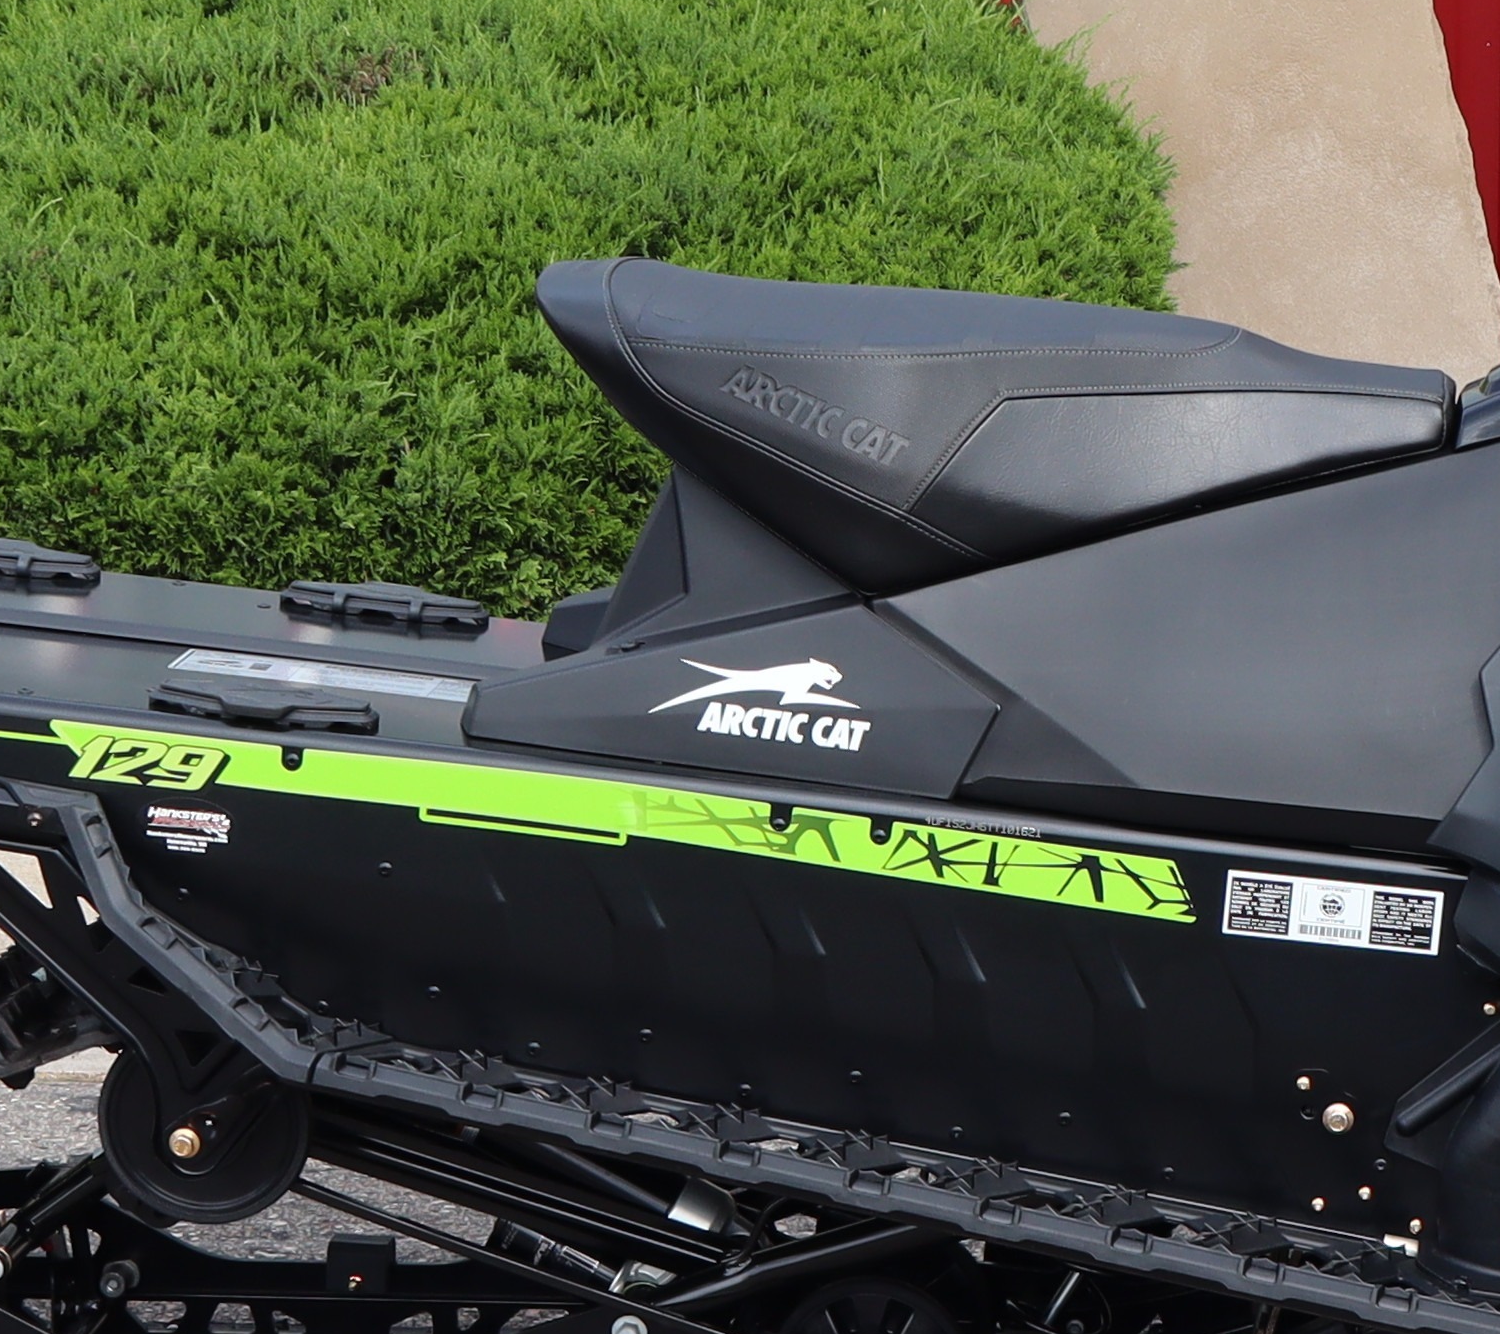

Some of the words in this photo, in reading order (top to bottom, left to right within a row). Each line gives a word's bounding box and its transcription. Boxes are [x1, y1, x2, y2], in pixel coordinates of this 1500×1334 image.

[719, 364, 846, 438] ARCTIC
[841, 417, 910, 466] CAT
[696, 701, 810, 744] ARCTIC
[811, 716, 871, 752] CAT
[68, 734, 228, 791] 129
